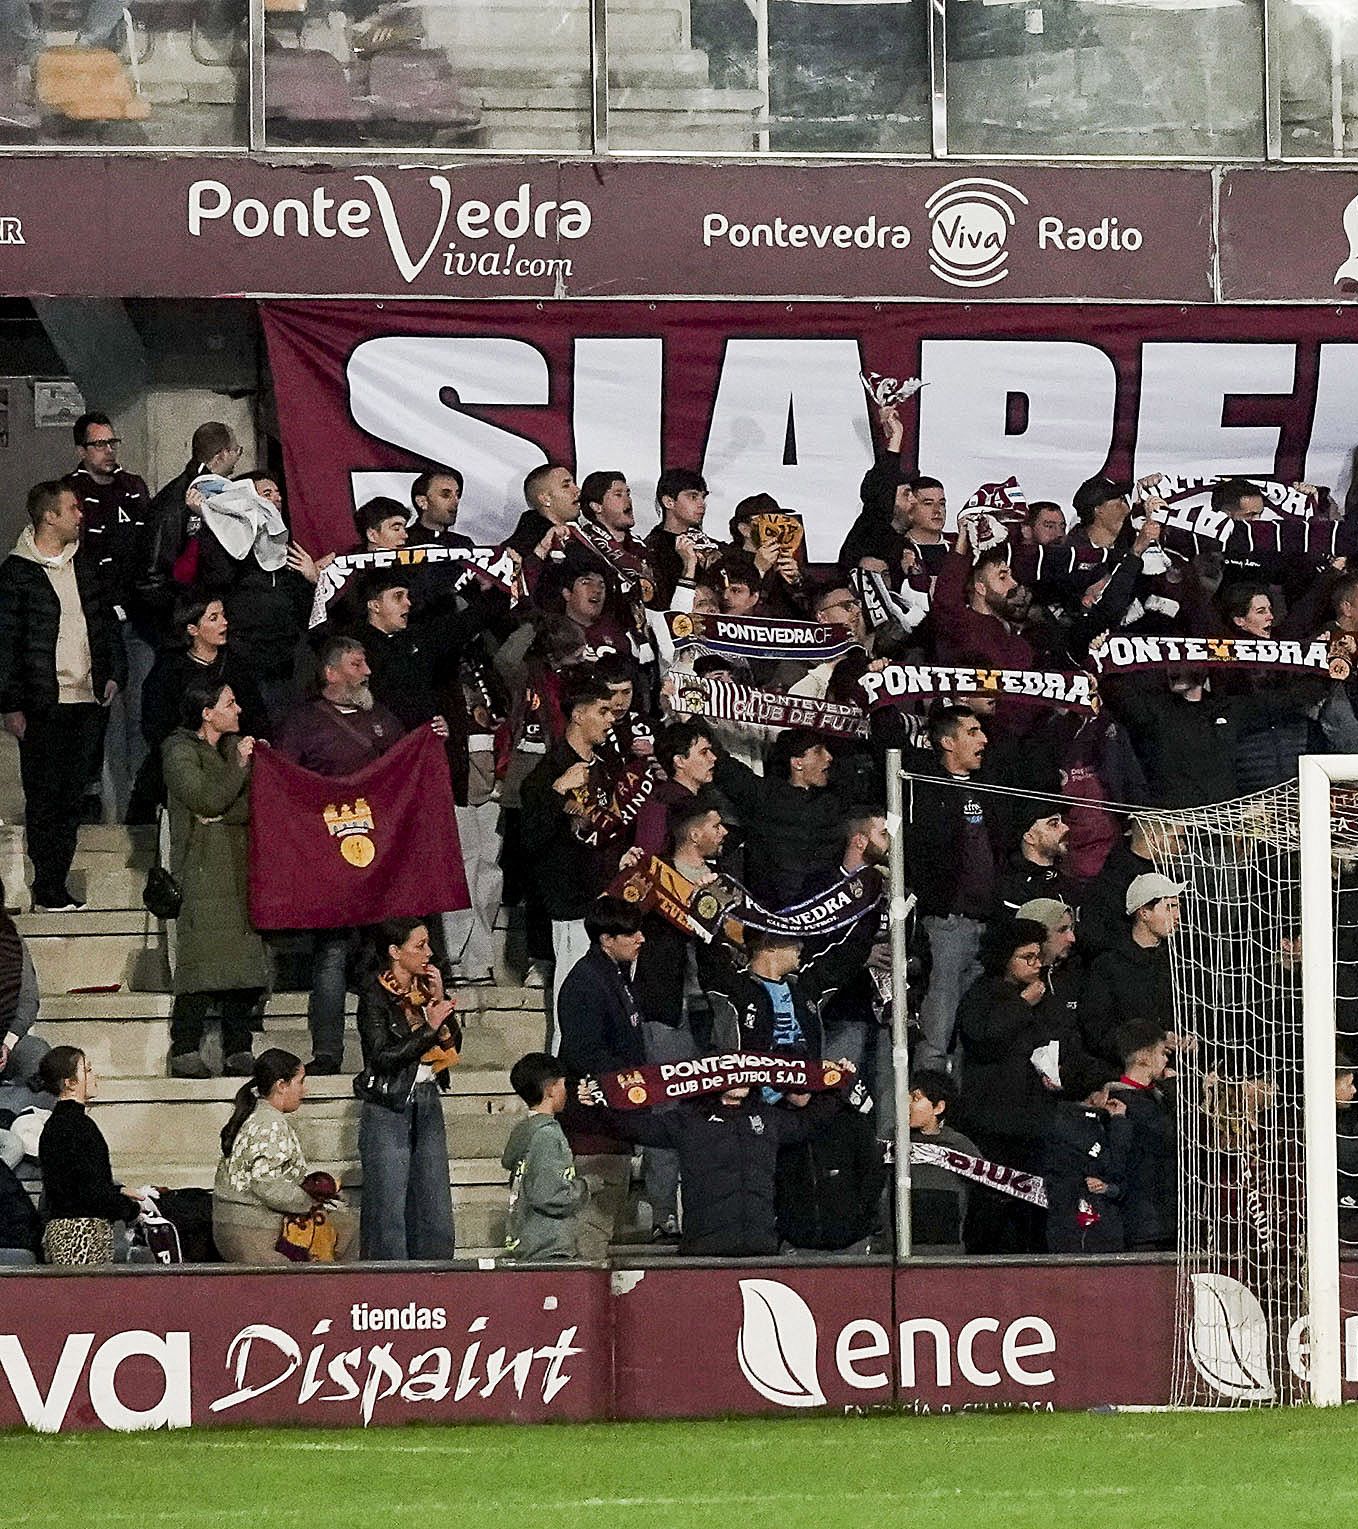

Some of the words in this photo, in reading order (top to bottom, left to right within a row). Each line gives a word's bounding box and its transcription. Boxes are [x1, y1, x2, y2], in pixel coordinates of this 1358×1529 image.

[188, 175, 592, 283] PonteVedra
[702, 213, 911, 250] Pontevedra
[937, 214, 1002, 251] Viva
[1038, 216, 1143, 252] Radio
[1089, 637, 1330, 674] PONTEVEDRA
[858, 665, 1092, 706] PONTEVEDRA
[789, 712, 815, 727] DE
[665, 1081, 699, 1097] CLUB
[727, 1072, 772, 1086] FUTBOL
[775, 1071, 807, 1086] S.A.D.
[351, 1302, 447, 1332] tiendas
[208, 1316, 586, 1428] Dispaint
[835, 1316, 1056, 1390] ence
[0, 1329, 192, 1433] va
